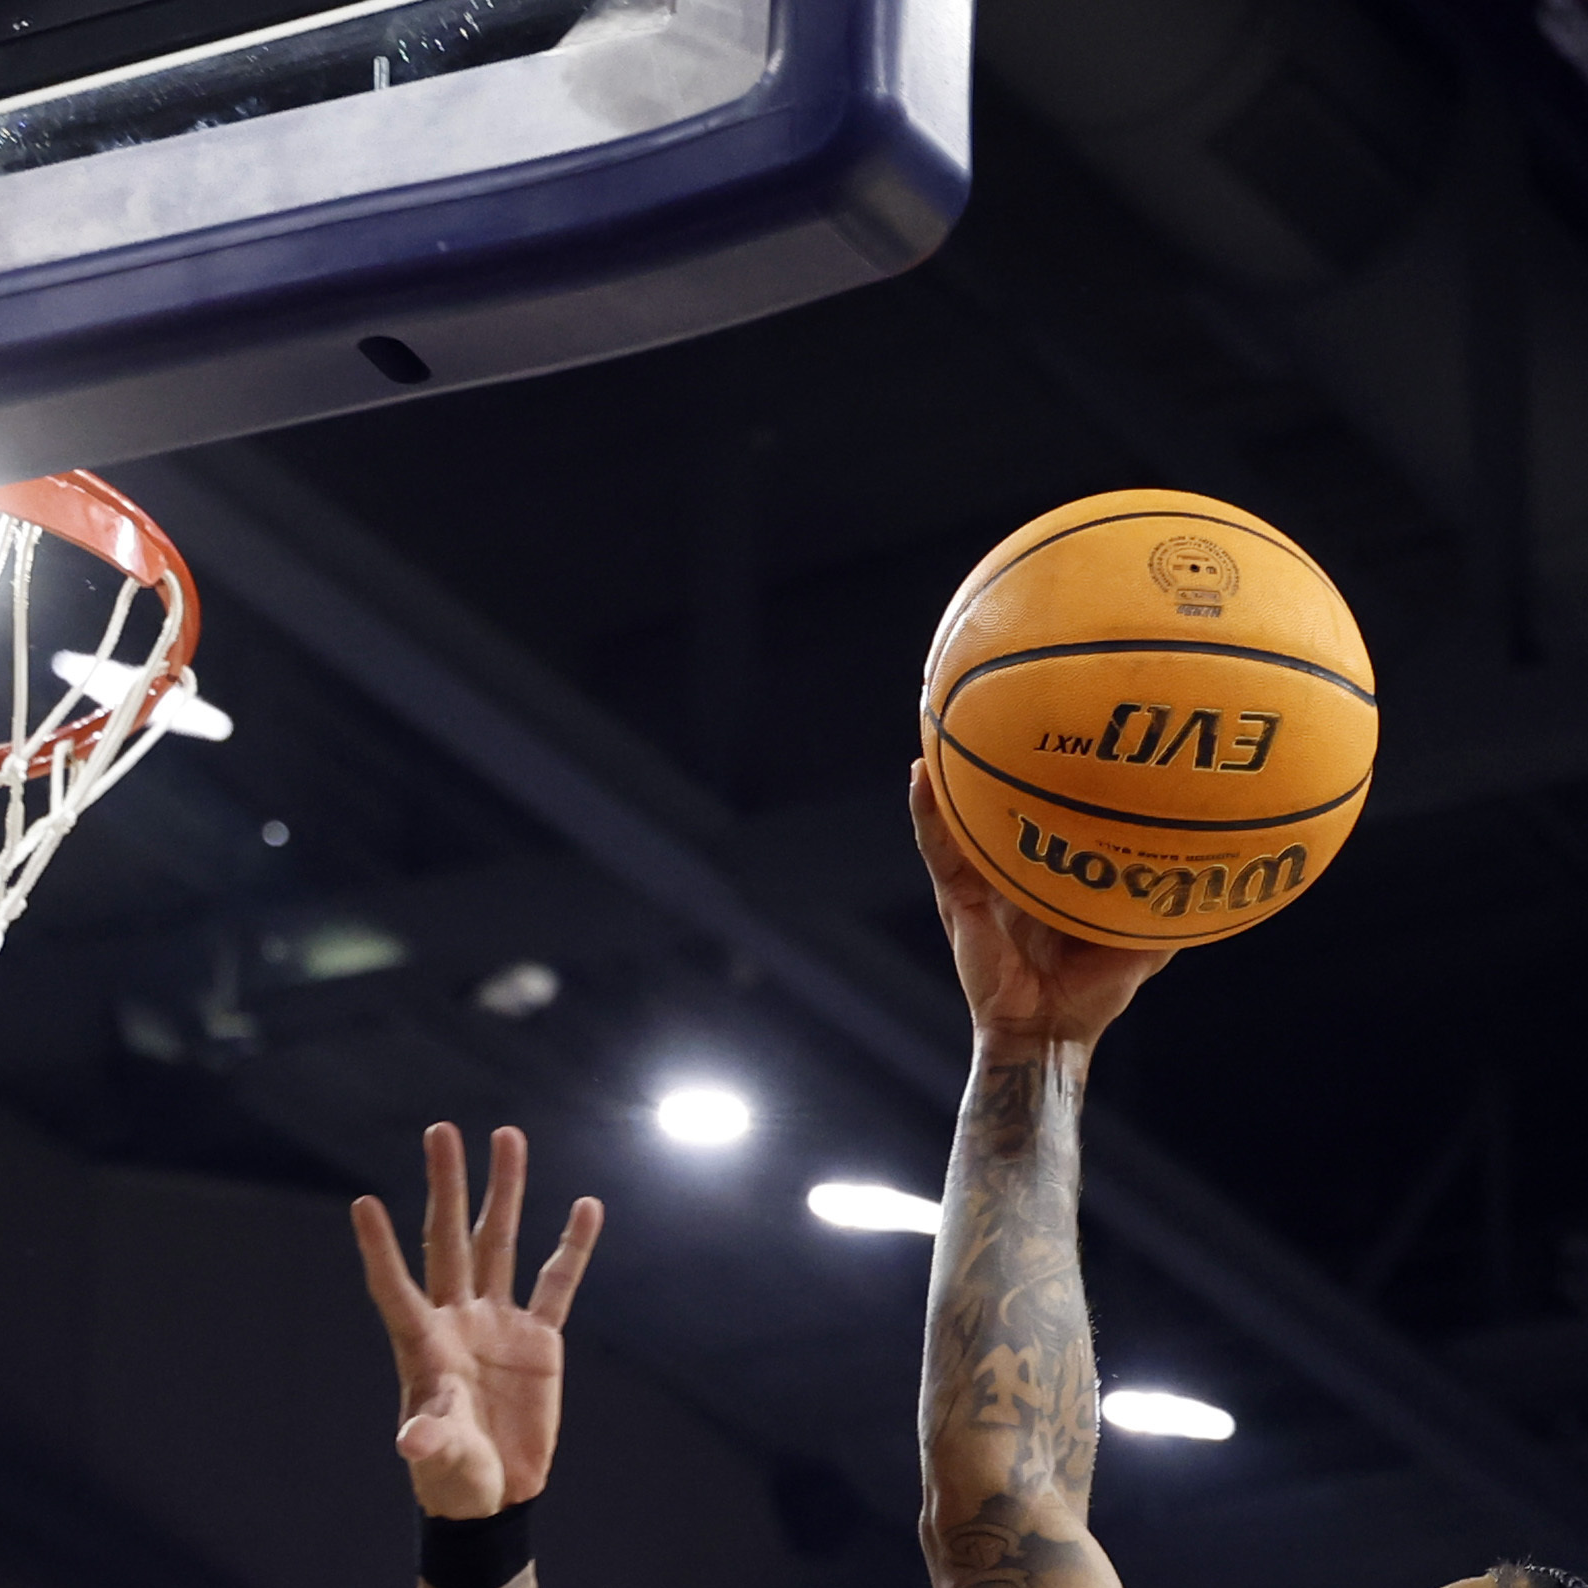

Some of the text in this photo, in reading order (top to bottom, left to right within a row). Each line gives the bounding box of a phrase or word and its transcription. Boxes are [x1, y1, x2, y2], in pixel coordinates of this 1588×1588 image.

[1033, 702, 1282, 774] EVO NXT
[1016, 814, 1308, 919] Wilson
